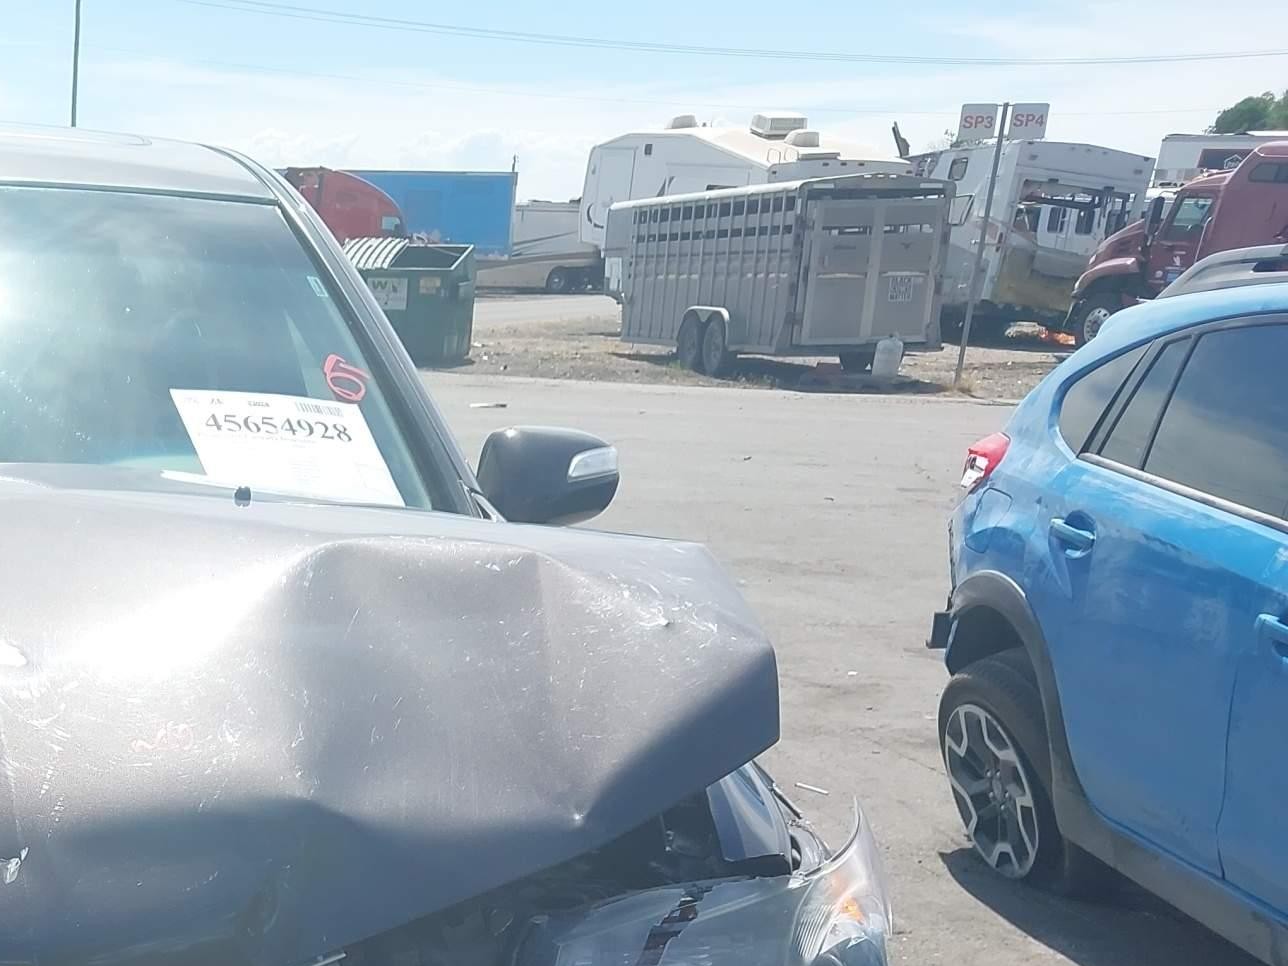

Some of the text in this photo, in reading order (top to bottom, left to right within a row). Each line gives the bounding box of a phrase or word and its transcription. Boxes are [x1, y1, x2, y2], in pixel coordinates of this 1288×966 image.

[962, 115, 994, 129] SP3
[1013, 113, 1044, 127] SP4
[204, 412, 353, 444] 45654928
